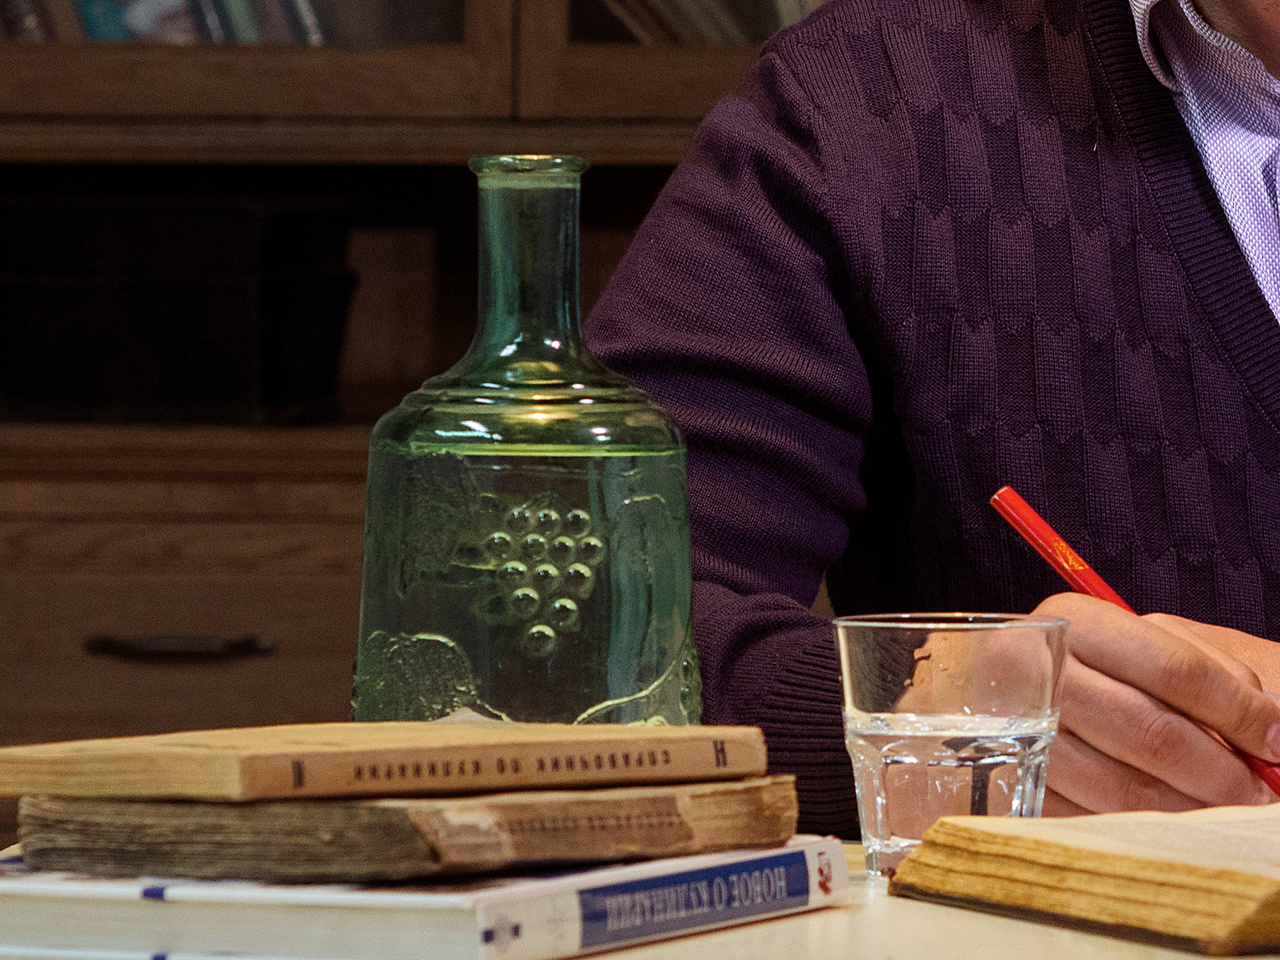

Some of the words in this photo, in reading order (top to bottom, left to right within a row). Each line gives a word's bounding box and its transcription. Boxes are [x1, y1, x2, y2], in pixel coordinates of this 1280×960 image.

[354, 759, 482, 781] КУЛИНАРИИ
[496, 758, 520, 774] ПО
[536, 749, 671, 773] СПРАВОЧНИК
[713, 876, 727, 911] О
[729, 866, 787, 908] НОВОЕ
[605, 878, 710, 932] КУЛИНАРИИ
